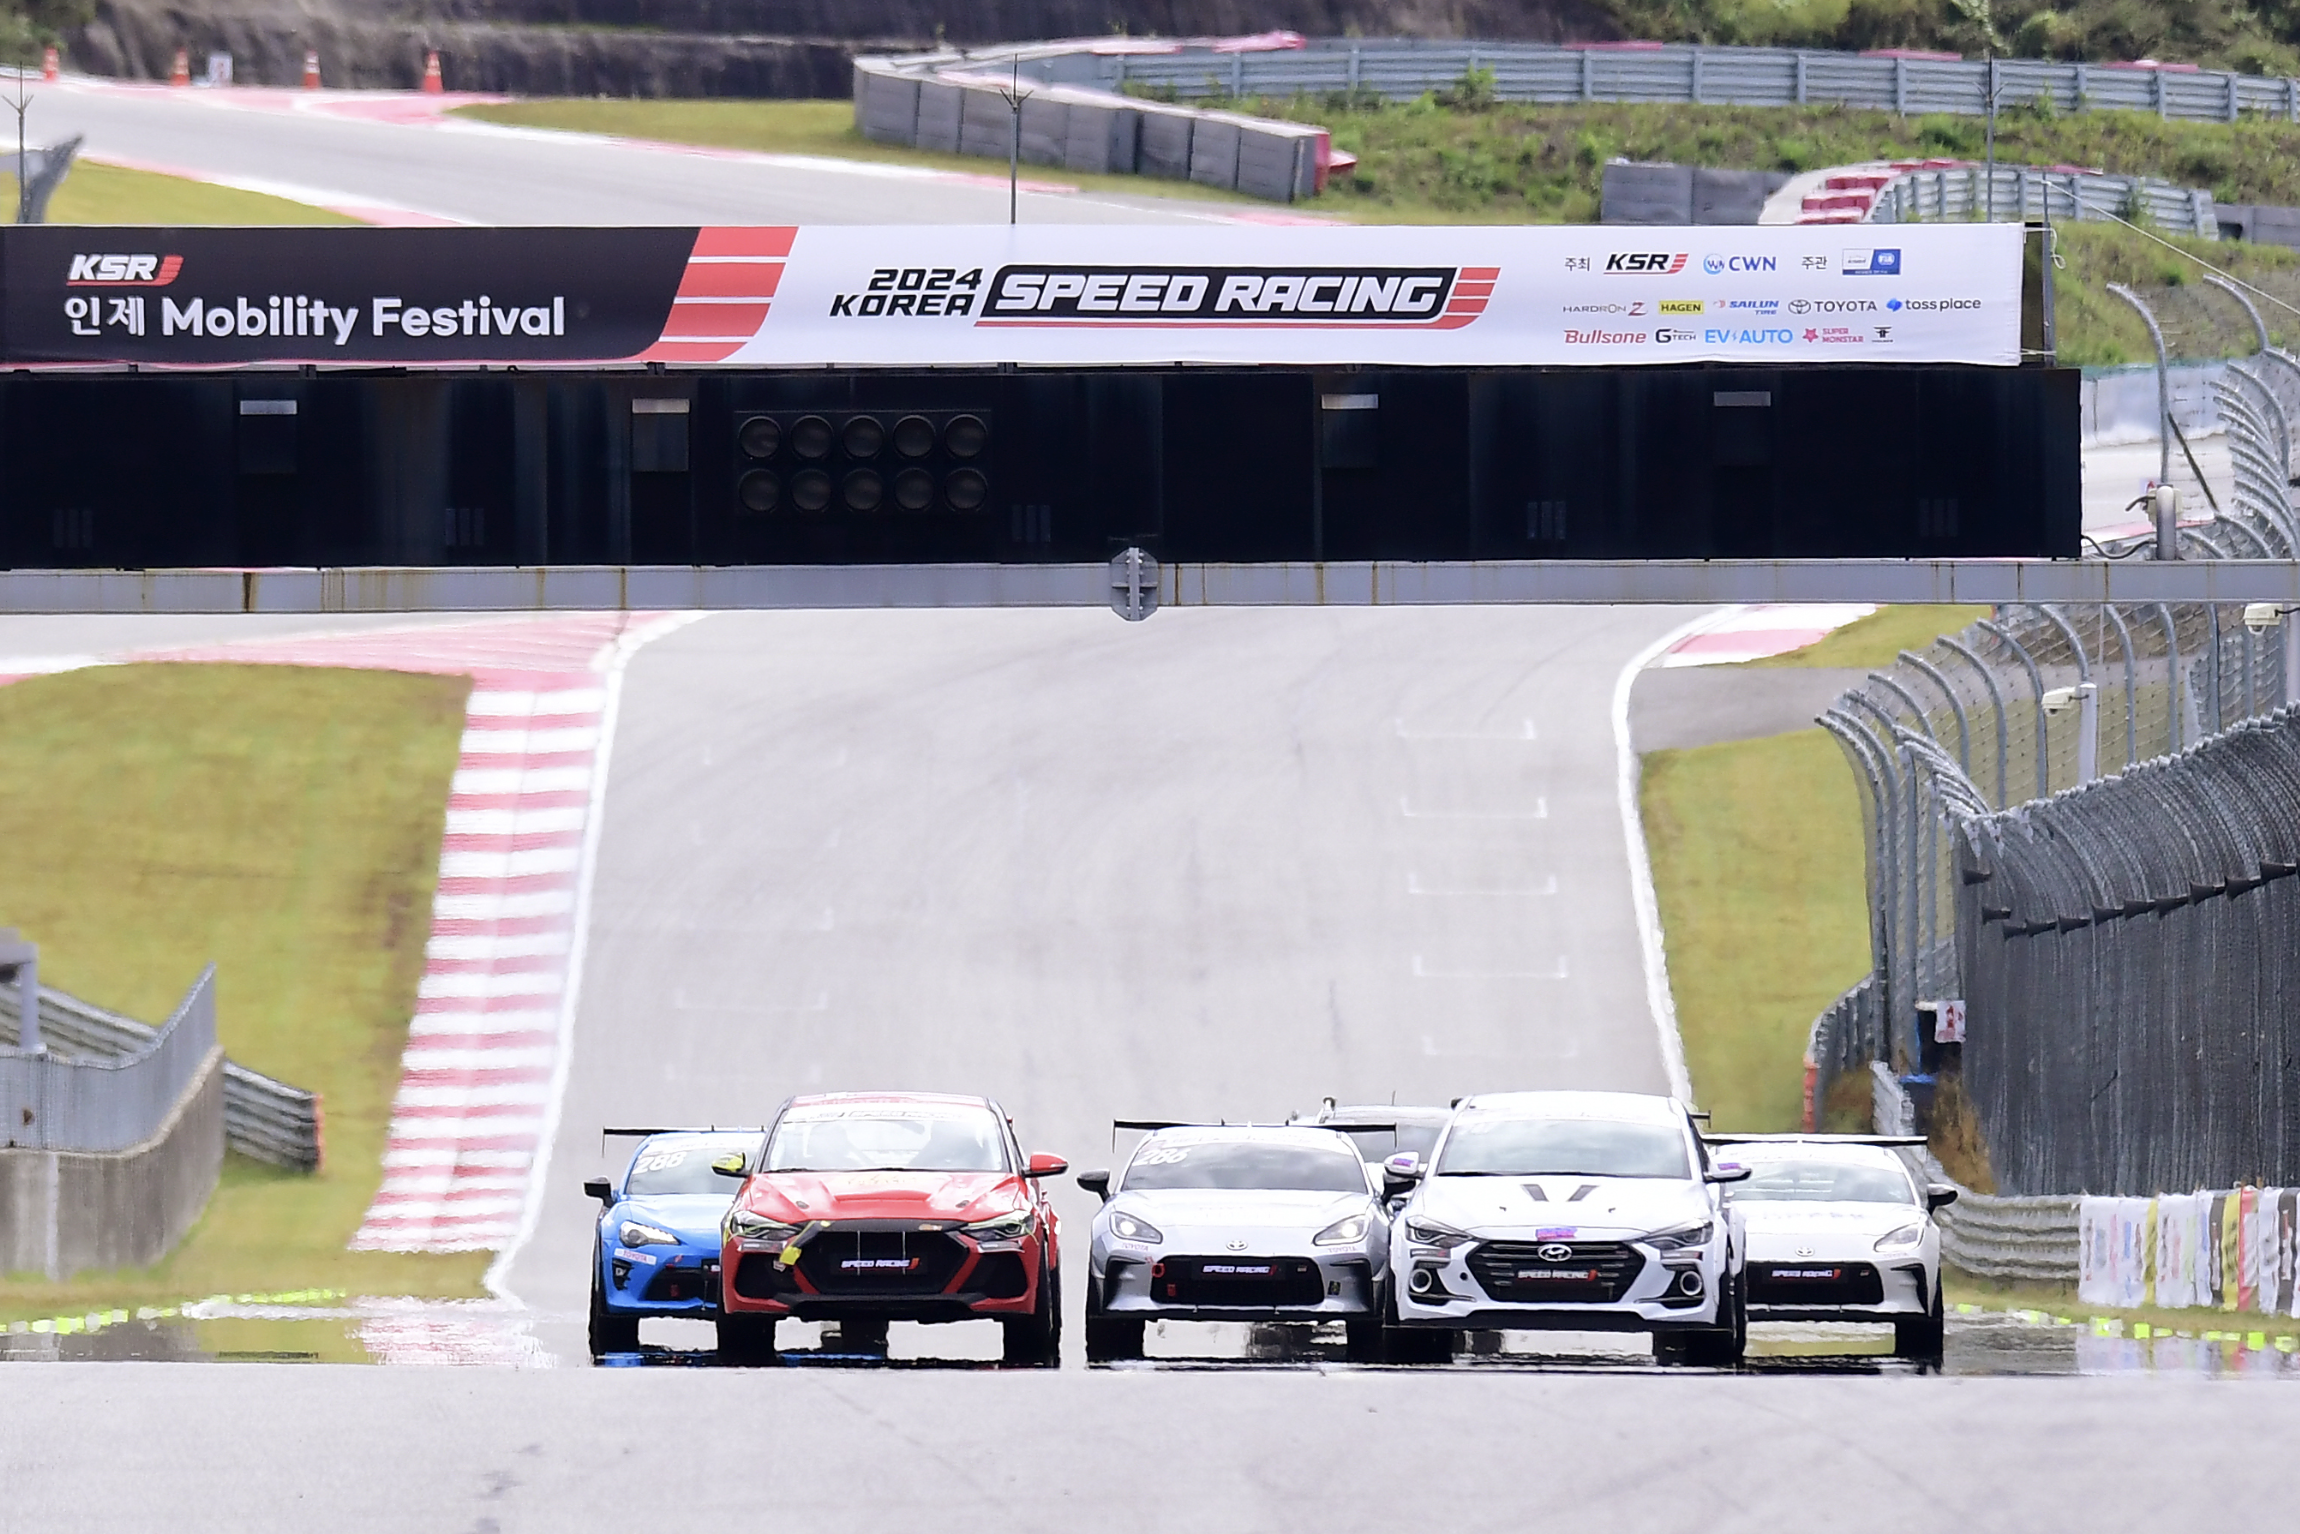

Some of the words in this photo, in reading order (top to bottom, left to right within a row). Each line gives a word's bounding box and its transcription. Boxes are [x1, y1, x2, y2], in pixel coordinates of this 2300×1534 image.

[67, 254, 158, 281] KSR
[1564, 257, 1591, 272] 주최
[1605, 253, 1670, 271] KSR
[1728, 256, 1777, 271] CWN
[1801, 256, 1828, 270] 주관
[867, 268, 984, 291] 2024
[995, 274, 1210, 312] SPEED
[1214, 275, 1444, 312] RACING
[829, 294, 977, 317] KOREA
[1562, 303, 1627, 314] HARDRON
[1660, 303, 1702, 313] HAGEN
[1728, 300, 1780, 309] SAILUN
[1814, 300, 1878, 313] TOYOTA
[1905, 299, 1938, 311] toss
[1939, 298, 1982, 313] place
[64, 296, 146, 336] 인제
[161, 295, 359, 345] Mobility
[372, 295, 566, 337] Festival
[1564, 329, 1647, 344] Bullsone
[1822, 327, 1849, 335] SUPER
[632, 1151, 688, 1175] 288
[1131, 1147, 1191, 1167] 286
[622, 1249, 648, 1262] TOYOTA
